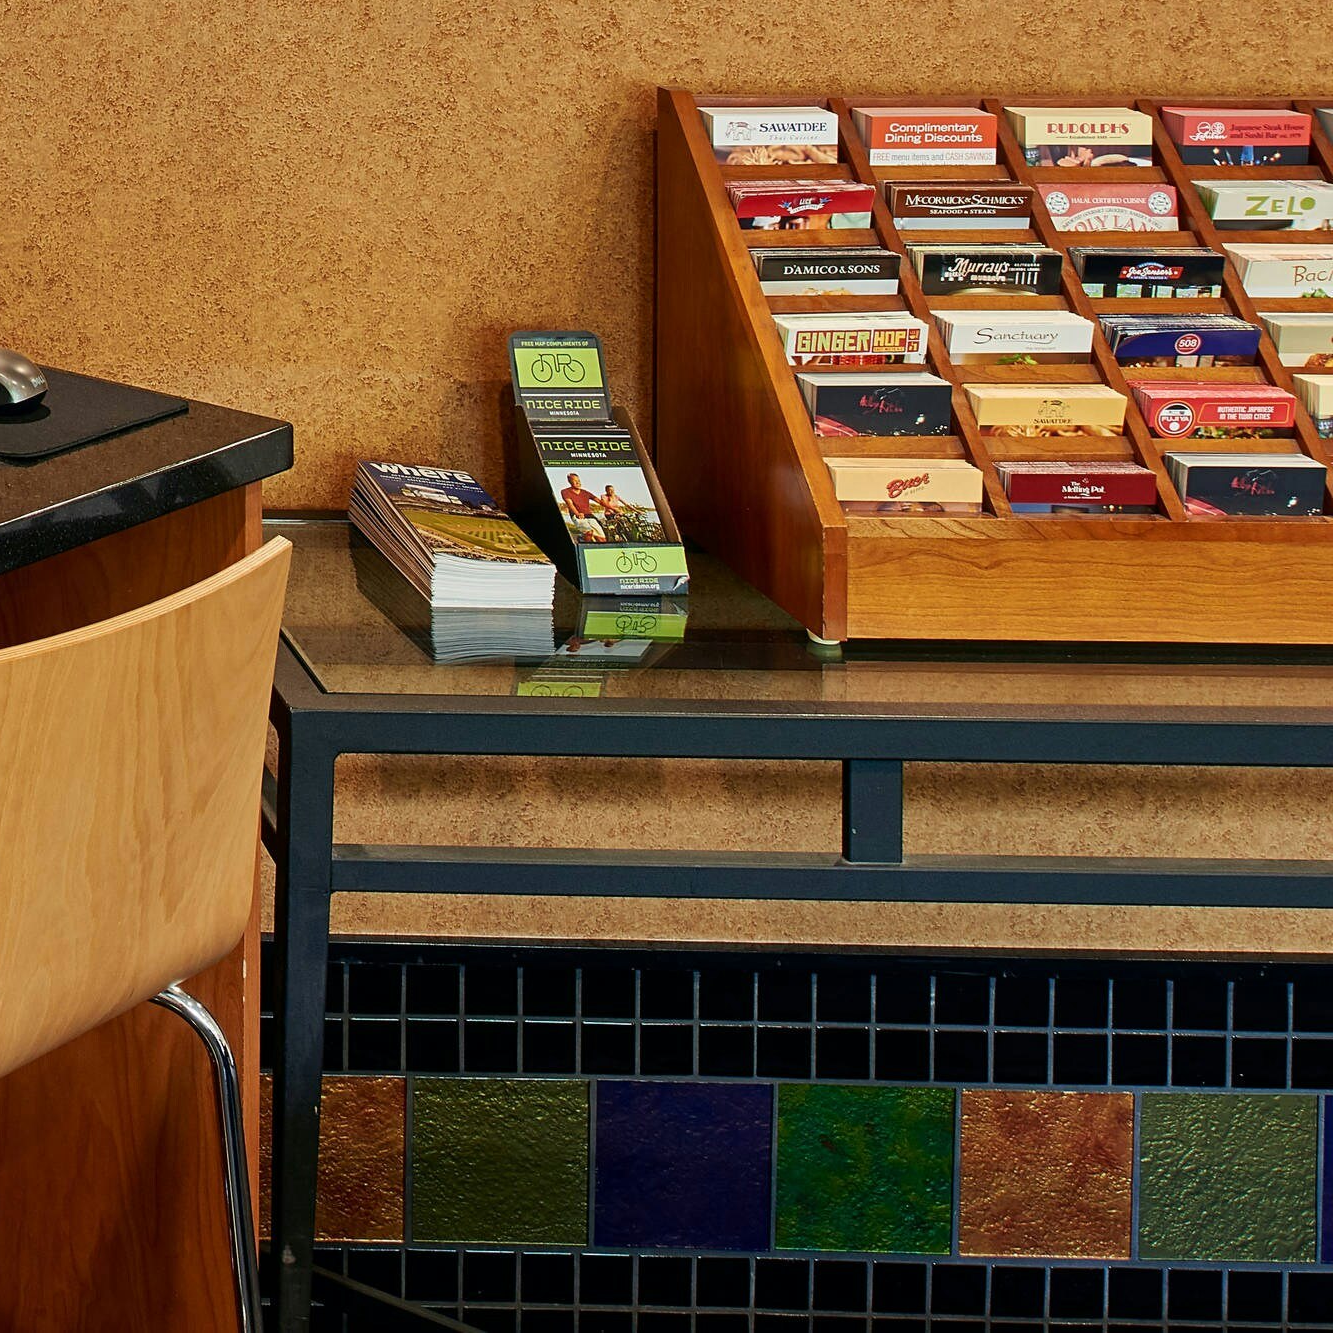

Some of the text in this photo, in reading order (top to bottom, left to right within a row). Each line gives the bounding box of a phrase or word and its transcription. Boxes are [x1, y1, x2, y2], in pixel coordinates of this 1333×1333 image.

[759, 122, 827, 133] SAWATDEE
[890, 123, 978, 133] Complimentary
[1047, 123, 1130, 135] RUDOLPHS
[1231, 124, 1261, 132] Japanese
[885, 134, 982, 144] Dining Discounts
[873, 153, 890, 161] FREE
[945, 152, 963, 160] CASH
[1245, 196, 1316, 216] ZELO
[784, 265, 839, 275] D'AMICO
[846, 265, 880, 274] SONS
[948, 258, 1011, 277] Murray's
[973, 328, 1058, 344] Sanctuary
[797, 331, 906, 352] GINGER HOP
[1179, 339, 1197, 348] 508
[526, 400, 600, 409] NICE RIDE
[540, 442, 631, 451] NICE RIDE
[370, 462, 475, 483] where
[1062, 486, 1090, 494] Melting
